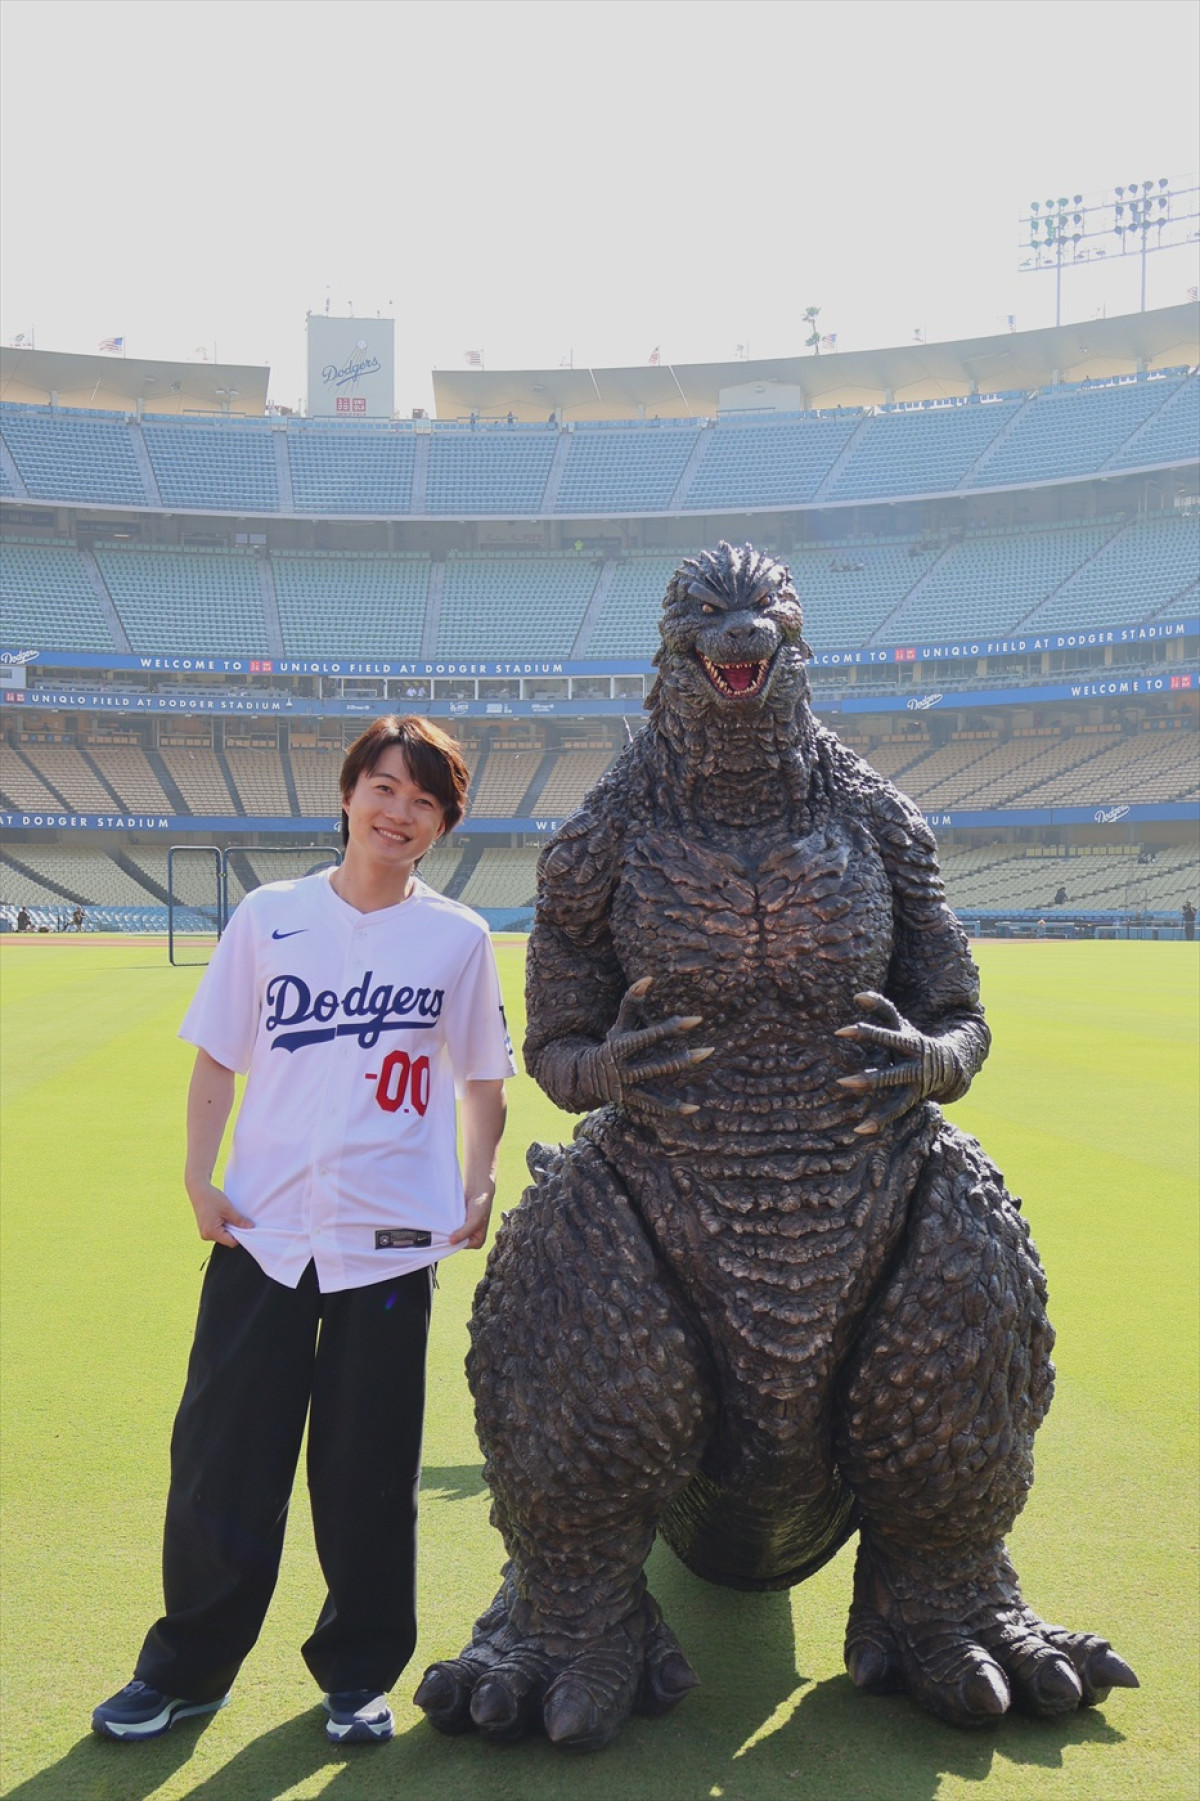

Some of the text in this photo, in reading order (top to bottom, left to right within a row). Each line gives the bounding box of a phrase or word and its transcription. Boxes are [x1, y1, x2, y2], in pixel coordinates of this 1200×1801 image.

[322, 357, 381, 386] Dodgers
[804, 652, 861, 665] ELCOME
[870, 651, 887, 661] TO
[922, 644, 979, 658] UNIQLO
[987, 639, 1026, 653] FIELD
[1033, 638, 1049, 649] AT
[1057, 632, 1114, 647] DODGER
[1121, 623, 1185, 641] STADIUM
[140, 658, 214, 670] WELCOME
[224, 661, 242, 671] TO
[280, 662, 341, 673] UNIQLO
[349, 663, 391, 673] FIELD
[399, 664, 416, 673] AT
[425, 664, 486, 674] DODGER
[495, 663, 563, 674] STADIUM
[1070, 681, 1139, 697] WELCOME
[1146, 678, 1163, 690] TO
[32, 694, 86, 705] UNIQLO
[93, 696, 130, 706] FIELD
[136, 698, 152, 707] AT
[158, 699, 214, 709] DODGER
[220, 700, 280, 710] STADIUM
[22, 816, 88, 827] DODGER
[97, 817, 169, 828] STADIUM
[266, 971, 445, 1052] Dodgers
